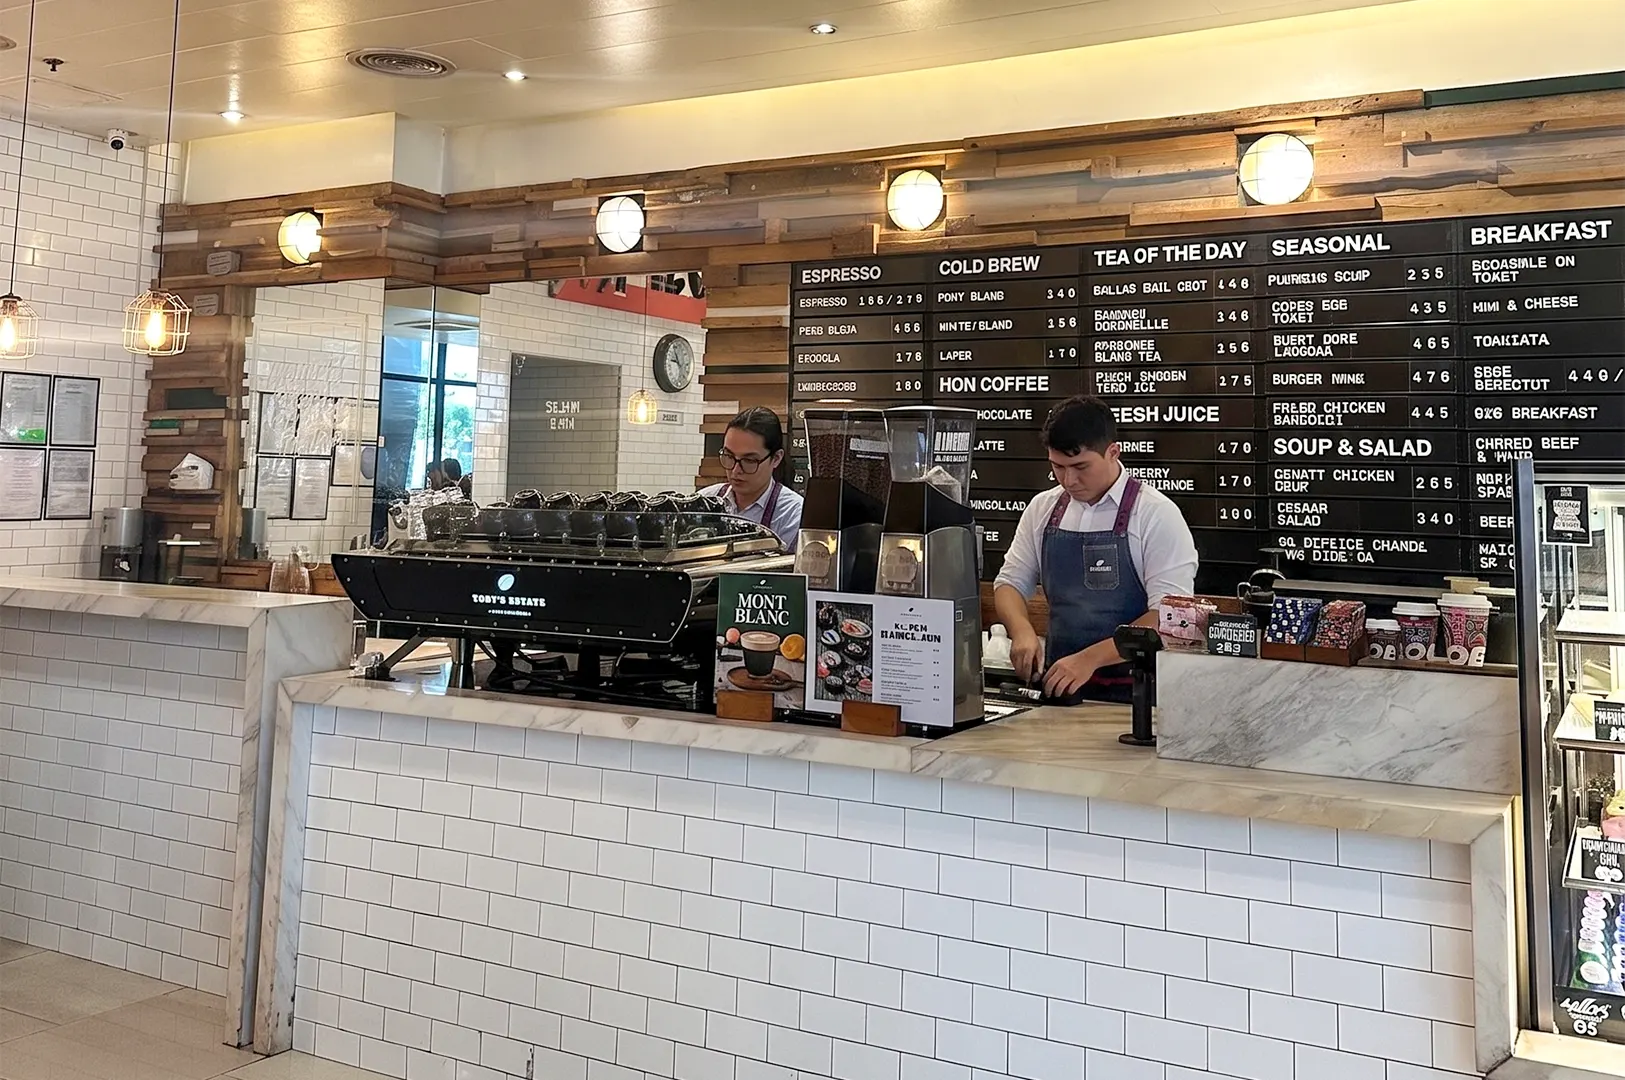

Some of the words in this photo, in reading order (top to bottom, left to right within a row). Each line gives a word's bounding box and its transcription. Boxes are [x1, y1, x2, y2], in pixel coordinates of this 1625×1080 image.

[1471, 220, 1612, 245] BREAKFAST
[1272, 234, 1390, 256] SEASONAL
[1094, 250, 1130, 266] TEA
[1134, 247, 1158, 263] OF
[1162, 244, 1201, 262] THE
[1206, 242, 1246, 259] DAY
[940, 259, 984, 275] COLD
[988, 256, 1040, 272] BREW
[1556, 256, 1575, 267] ON
[802, 266, 881, 284] ESPRESSO
[938, 292, 964, 302] PONY
[1048, 288, 1075, 299] 340
[1410, 302, 1446, 314] 435
[1507, 300, 1517, 311] &
[1525, 296, 1578, 309] CHEESE
[1274, 335, 1314, 347] BUERT
[1324, 333, 1358, 344] DORE
[1413, 337, 1449, 349] 465
[940, 351, 972, 360] LAPER
[1049, 348, 1076, 358] 170
[1138, 351, 1161, 361] TEA
[940, 377, 976, 392] HON
[981, 376, 1049, 391] COFFEE
[1273, 374, 1322, 385] BURGER
[1413, 371, 1449, 382] 476
[1324, 402, 1385, 413] CHICKEN
[1412, 407, 1448, 418] 445
[1512, 407, 1597, 419] BREAKFAST
[1163, 406, 1219, 422] JUICE
[1274, 438, 1332, 455] SOUP
[1338, 439, 1353, 456] &
[1359, 439, 1432, 456] SALAD
[1542, 437, 1579, 449] BEEF
[1219, 476, 1251, 487] 170
[1333, 470, 1394, 481] CHICKEN
[1416, 477, 1452, 489] 265
[1278, 515, 1320, 526] SALAD
[1417, 513, 1453, 524] 340
[472, 594, 506, 604] TOBY'S
[508, 597, 545, 606] ESTATE
[738, 593, 787, 610] MONT
[734, 608, 789, 626] BLANC
